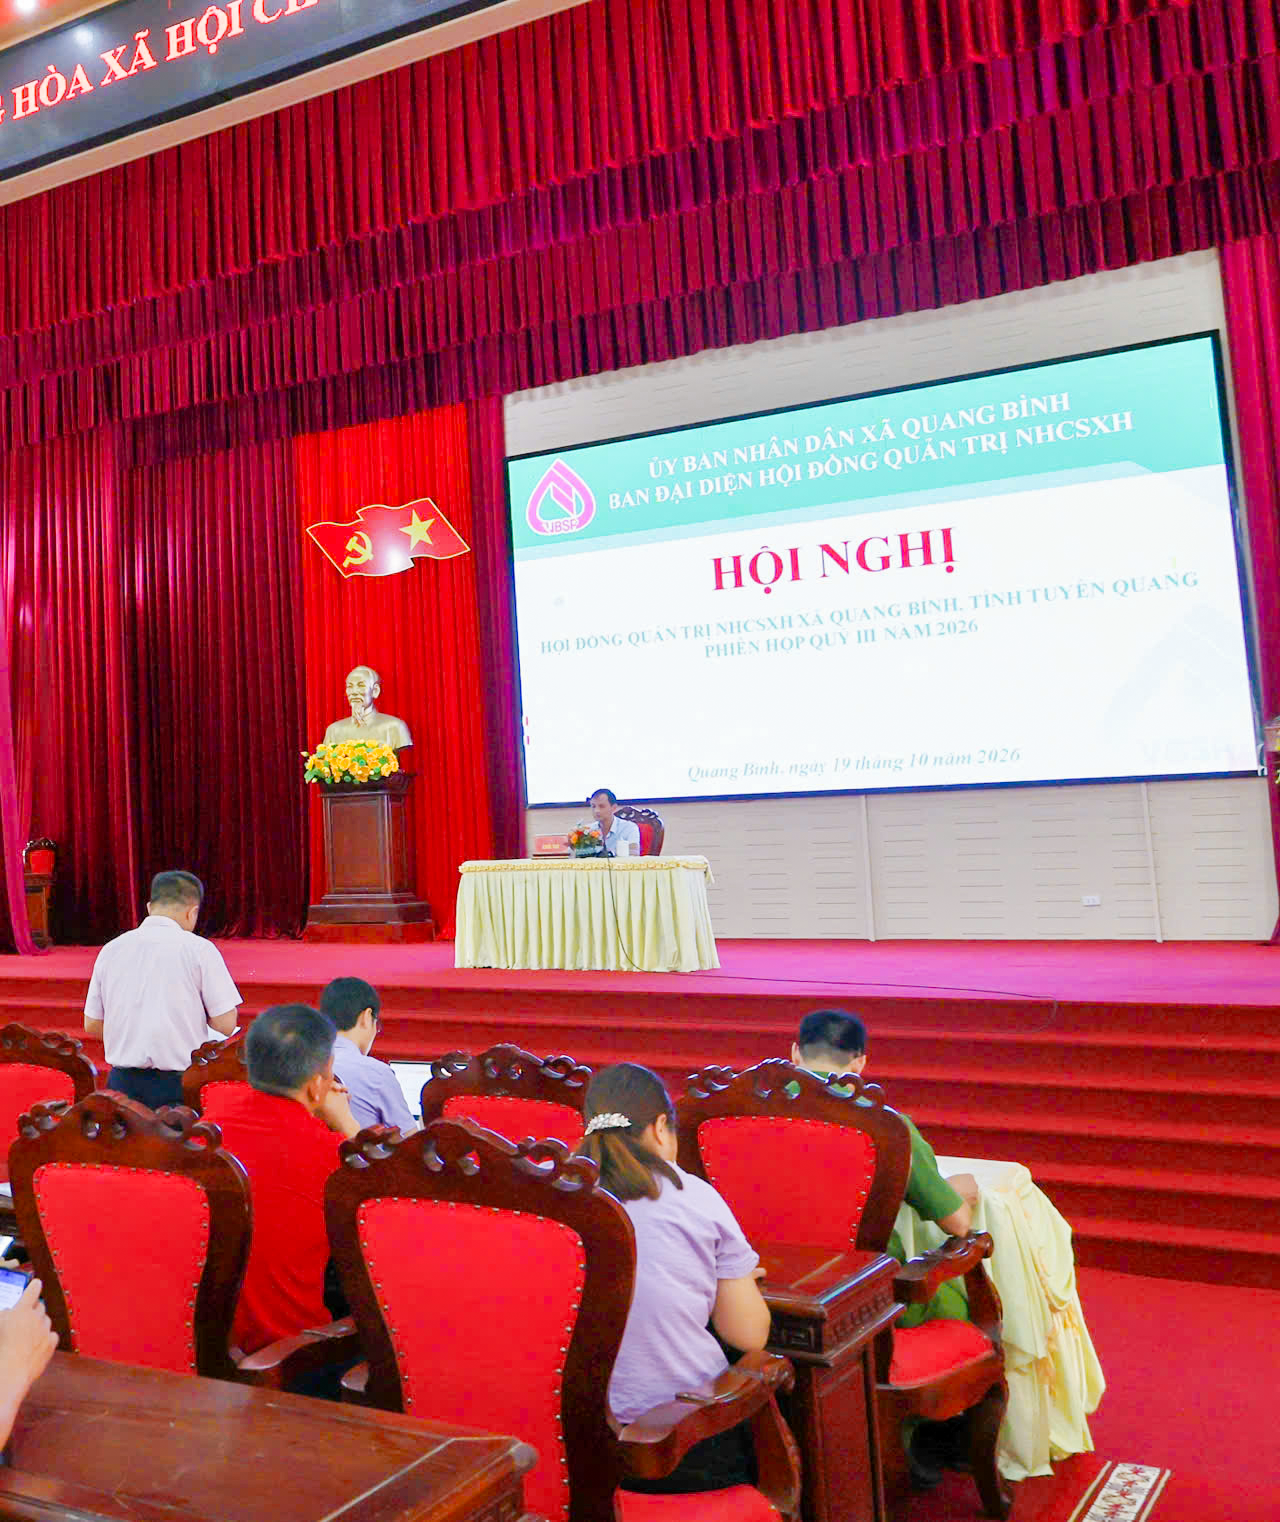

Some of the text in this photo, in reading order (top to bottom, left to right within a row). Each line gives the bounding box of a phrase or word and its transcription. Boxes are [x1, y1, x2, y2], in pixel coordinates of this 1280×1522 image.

[11, 64, 93, 120] HÒA
[99, 28, 158, 86] XÃ
[164, 0, 245, 62] HỘI
[608, 410, 1134, 510] BAN ĐẠI DIỆN HỘI ĐỒNG QUẢN TRỊ NHCSXH
[684, 450, 727, 474] BAN
[733, 436, 798, 465] NHÂN
[805, 427, 854, 451] DÂN
[861, 418, 896, 444] XÃ
[902, 404, 995, 439] QUANG
[1001, 391, 1071, 421] BÌNH
[711, 527, 960, 595] HỘI NGHỊ
[717, 615, 793, 637] NHCSXH
[830, 602, 902, 626] QUANG
[1112, 571, 1199, 597] QUANG
[856, 627, 876, 645] III
[936, 619, 979, 637] 2026
[687, 764, 739, 784] Quang
[833, 756, 851, 772] 19
[907, 752, 928, 768] 10
[976, 748, 1021, 763] 2026
